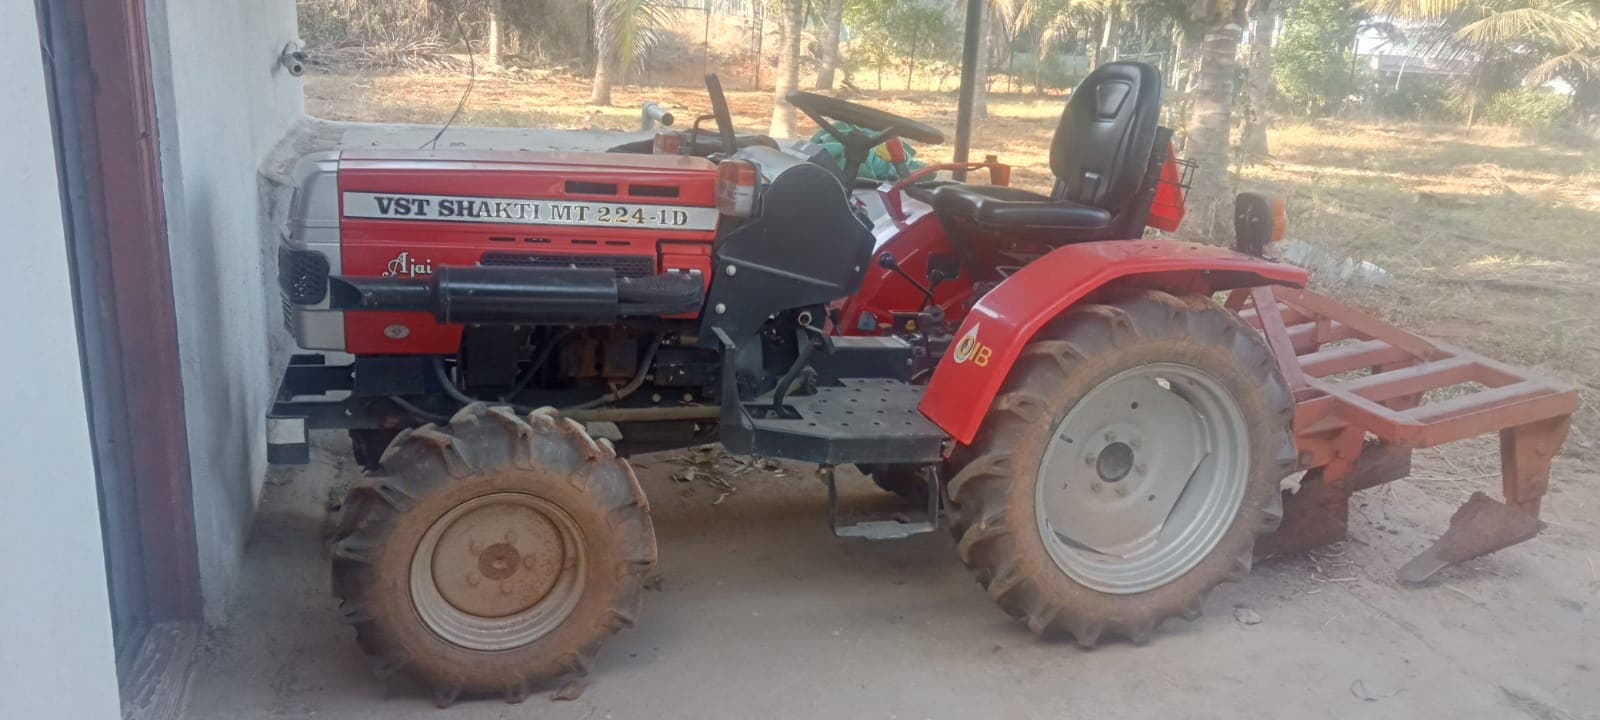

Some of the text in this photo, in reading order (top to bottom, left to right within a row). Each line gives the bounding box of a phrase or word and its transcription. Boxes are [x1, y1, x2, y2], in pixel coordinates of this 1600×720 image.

[374, 196, 688, 226] VST SHAKTI MT 224-1D
[382, 252, 432, 278] Ajai
